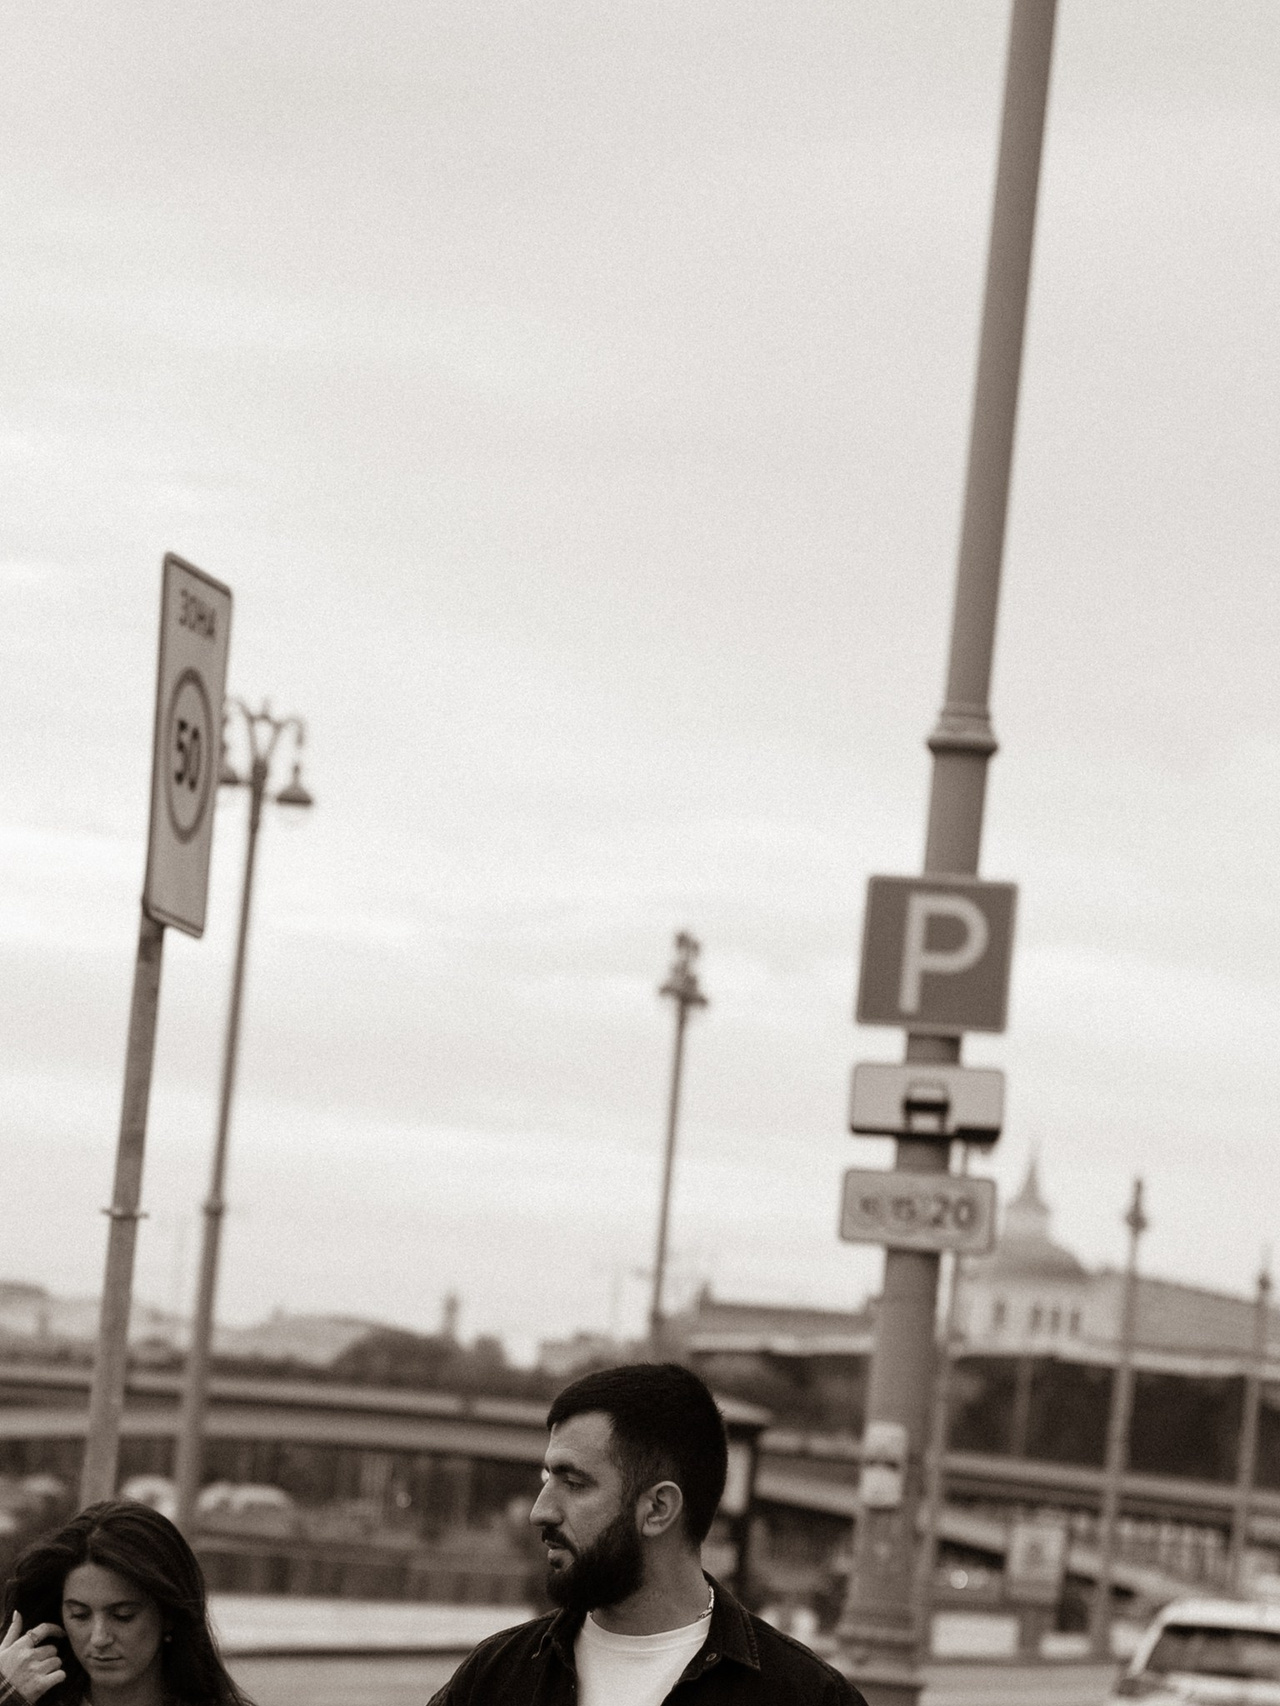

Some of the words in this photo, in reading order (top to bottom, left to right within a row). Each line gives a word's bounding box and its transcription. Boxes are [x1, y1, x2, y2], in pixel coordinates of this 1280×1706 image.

[175, 718, 200, 792] 50
[897, 891, 989, 1014] P
[926, 1192, 977, 1230] 20
